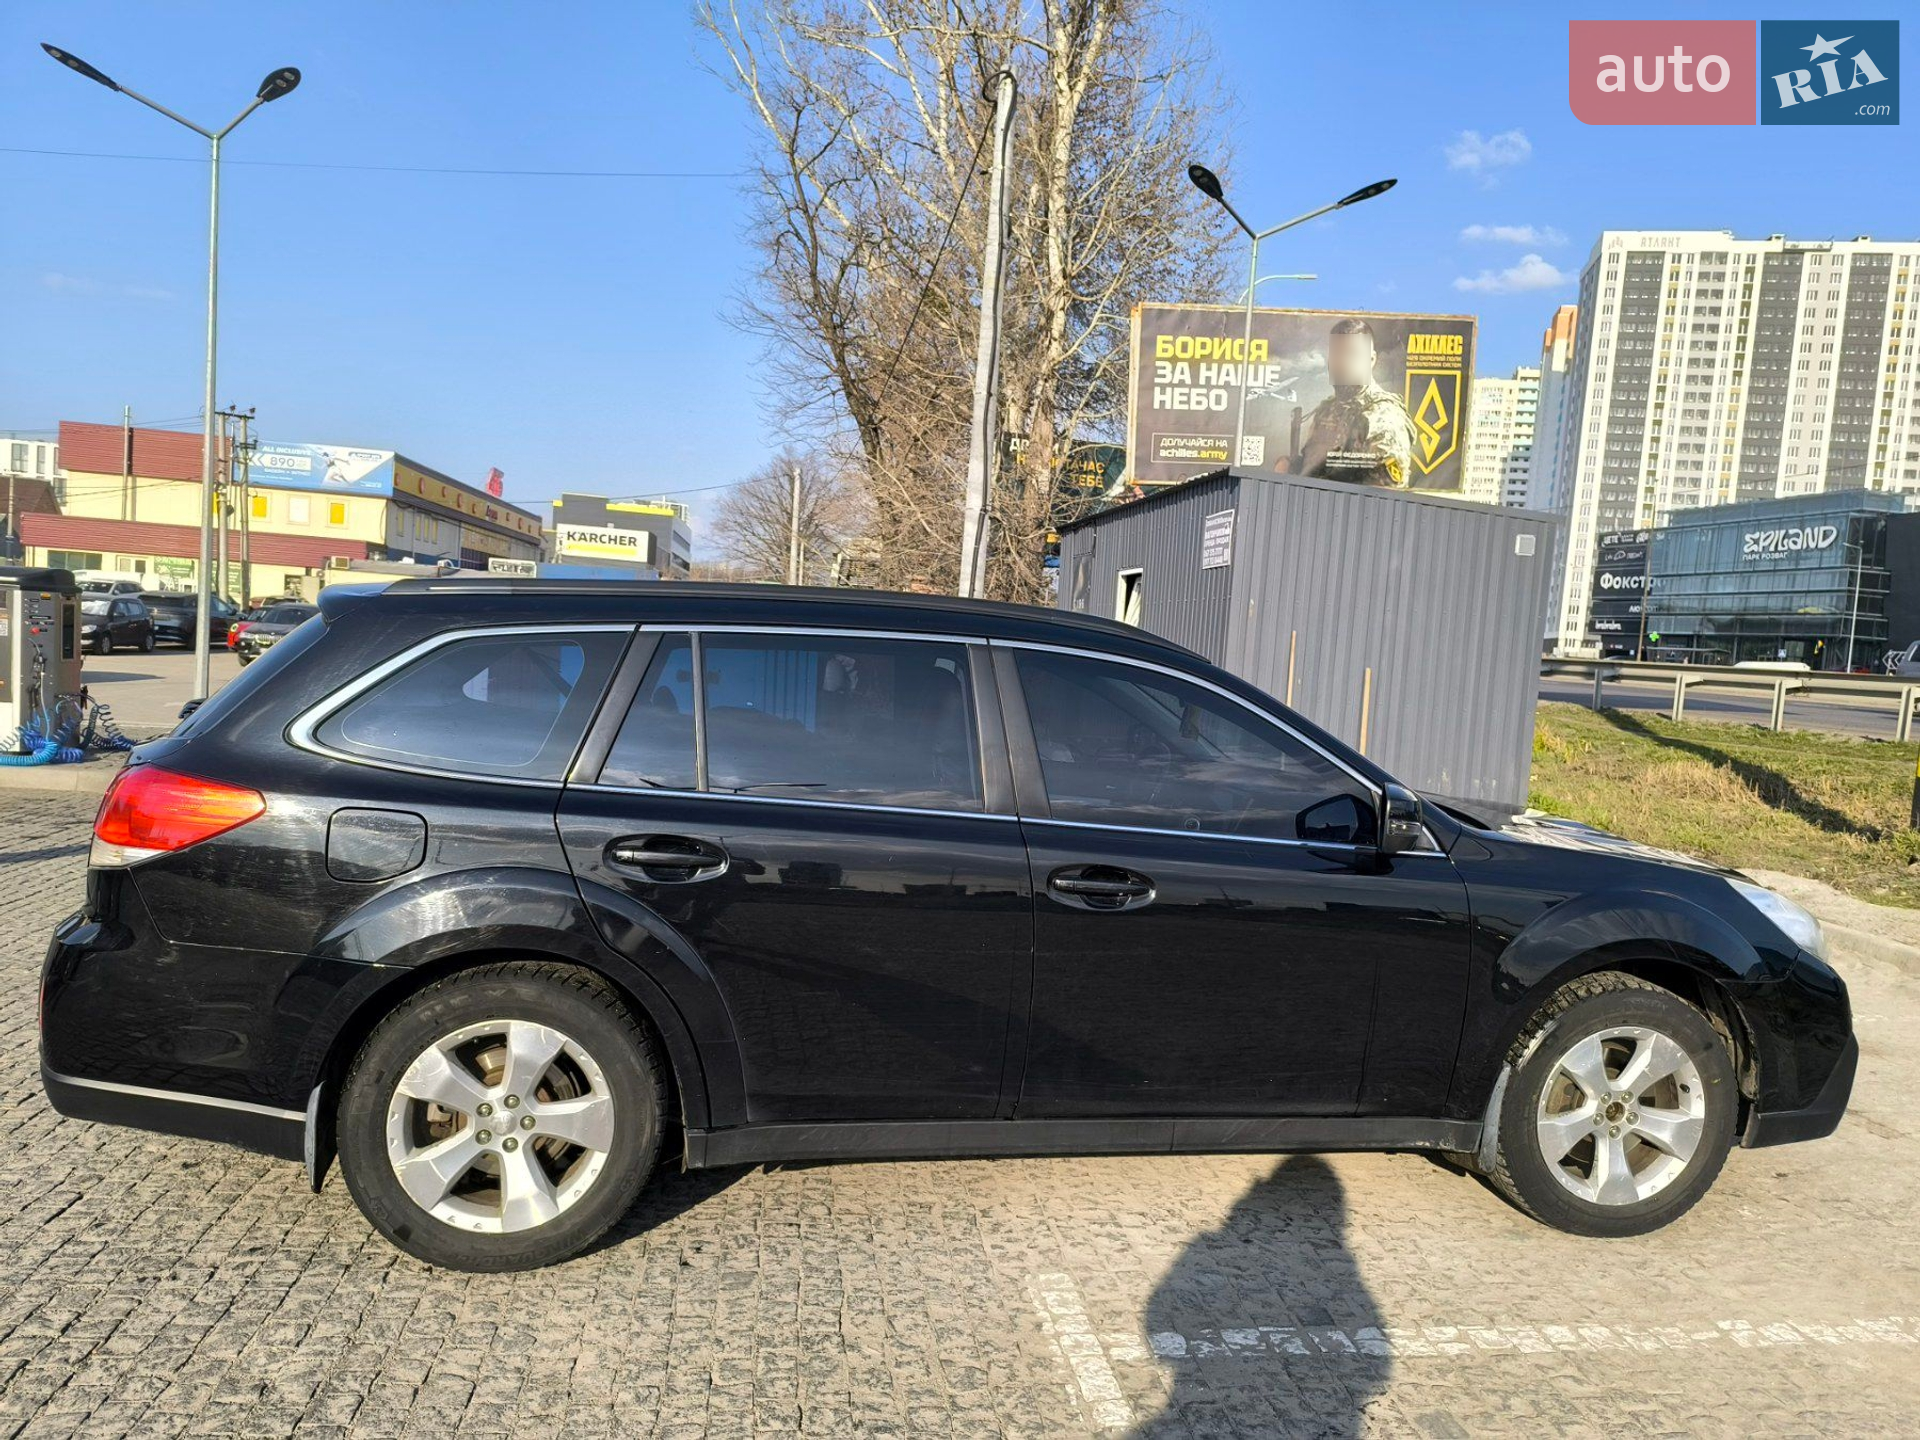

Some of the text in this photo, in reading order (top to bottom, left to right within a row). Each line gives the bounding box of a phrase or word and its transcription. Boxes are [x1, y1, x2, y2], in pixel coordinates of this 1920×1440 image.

[1155, 334, 1269, 361] БОРИСЯ
[1153, 360, 1281, 388] ЗА НАШЕ
[1153, 386, 1228, 411] НЕБО
[1160, 437, 1228, 448] ДОЛУЧАЙСЯ НА
[1159, 448, 1228, 461] achilles.army
[270, 457, 295, 468] 890
[566, 530, 637, 547] KÄRCHER
[1742, 551, 1788, 561] ПАРК РОЗВАГ
